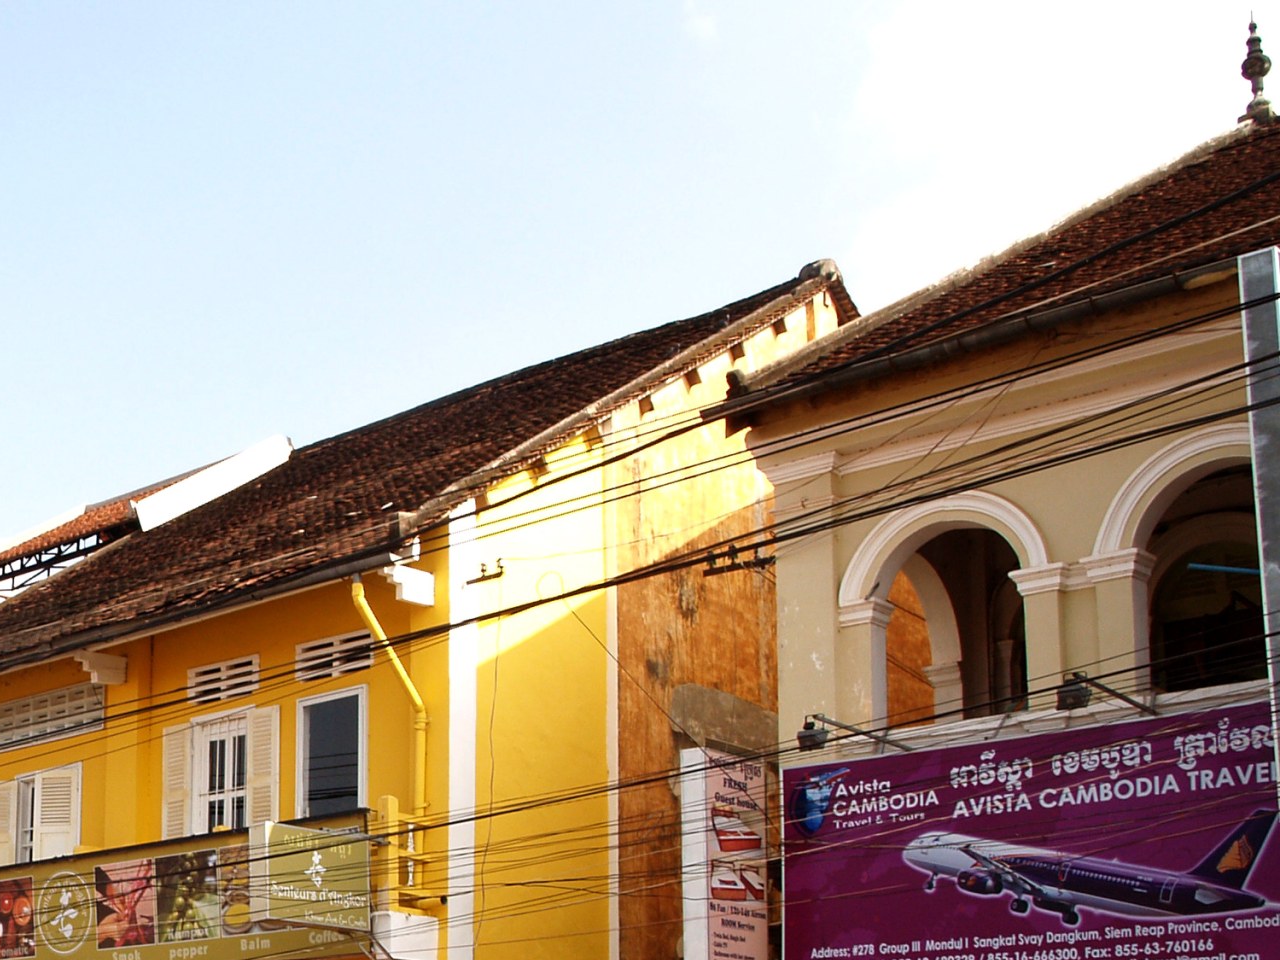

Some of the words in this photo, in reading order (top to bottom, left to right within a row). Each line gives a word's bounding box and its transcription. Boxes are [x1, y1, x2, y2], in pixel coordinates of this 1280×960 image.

[835, 779, 891, 797] Avista
[952, 793, 1033, 819] AVISTA
[1039, 774, 1180, 808] CAMBODIA
[832, 790, 939, 817] CAMBODIA
[833, 817, 871, 830] Travel
[890, 812, 925, 823] Tours
[168, 928, 209, 940] Kampot
[309, 930, 345, 944] Coffee
[879, 941, 909, 955] Group
[973, 935, 1016, 950] Sangkat
[1018, 932, 1044, 946] Svay
[1046, 929, 1102, 944] Dangkum,
[1105, 926, 1132, 939] Siem
[1135, 923, 1165, 938] Reap
[1168, 919, 1222, 935] Province,
[170, 945, 208, 960] pepper
[240, 939, 270, 951] Balm
[1085, 947, 1112, 959] Fax:
[1115, 939, 1214, 957] 855-63-760166
